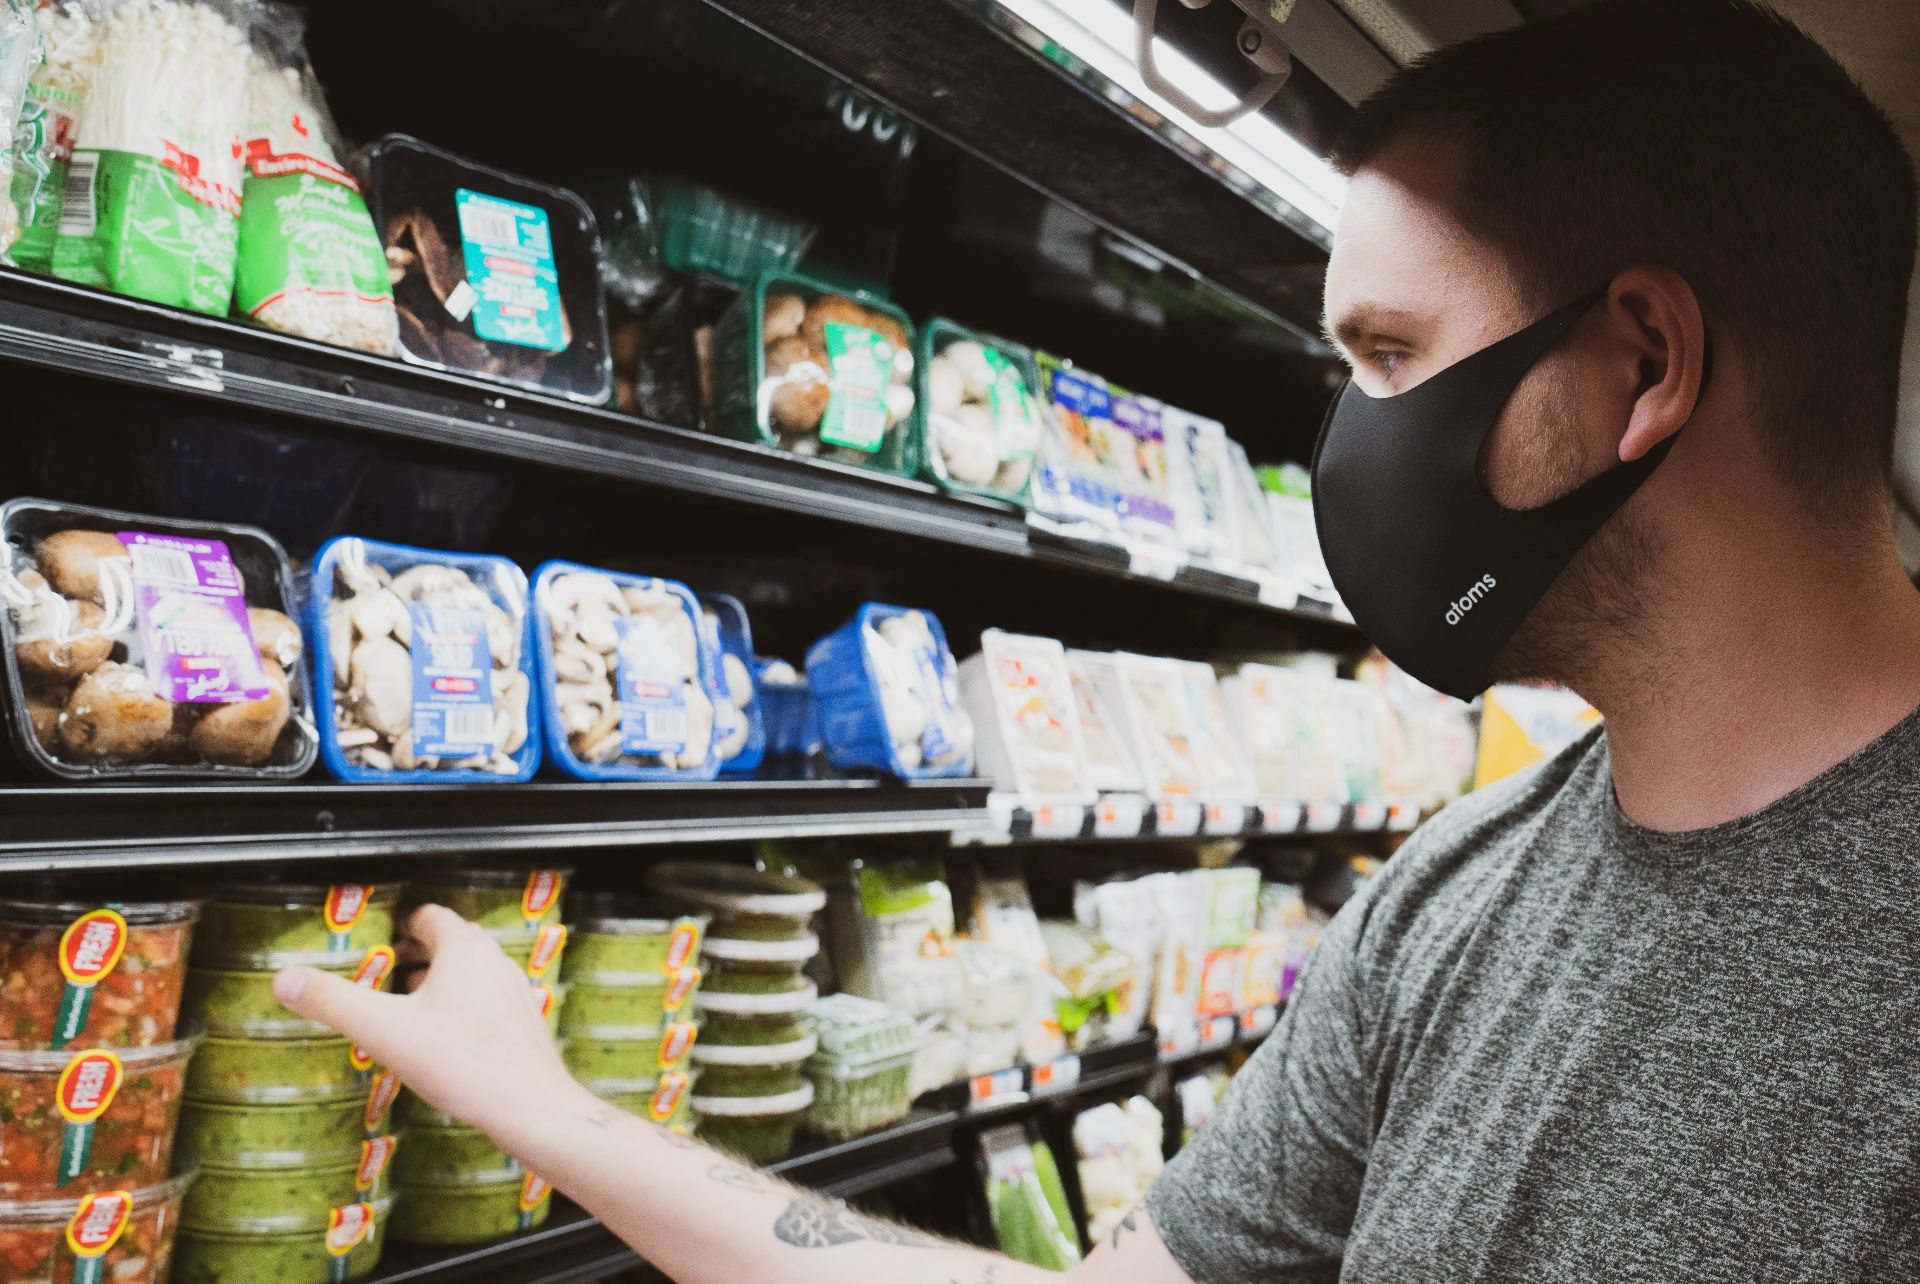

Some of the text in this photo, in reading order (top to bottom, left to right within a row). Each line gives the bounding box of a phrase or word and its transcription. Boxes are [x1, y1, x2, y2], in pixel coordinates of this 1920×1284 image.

[1445, 573, 1497, 626] atoms
[72, 920, 118, 971] FRESH
[69, 1060, 111, 1109] FRESH
[80, 1196, 123, 1243] FRESH
